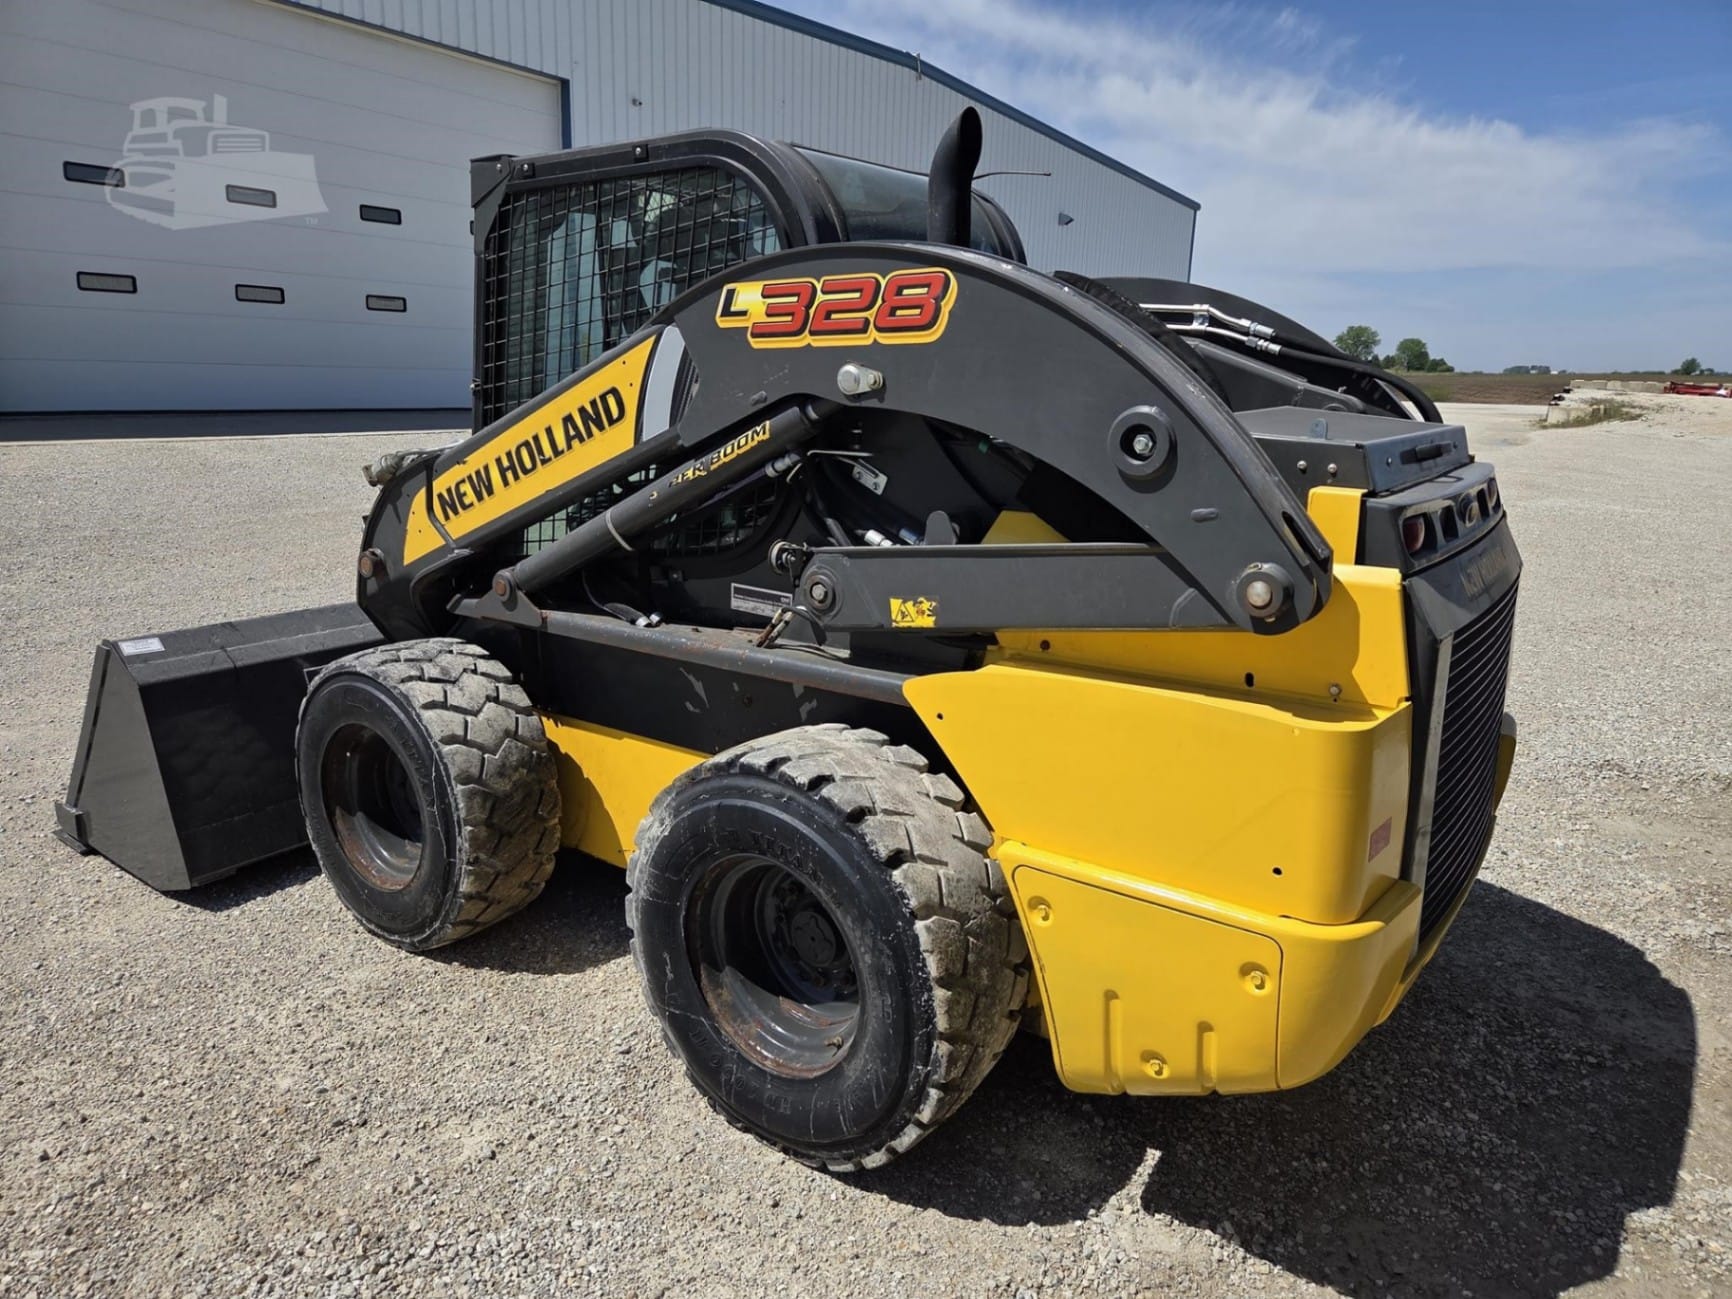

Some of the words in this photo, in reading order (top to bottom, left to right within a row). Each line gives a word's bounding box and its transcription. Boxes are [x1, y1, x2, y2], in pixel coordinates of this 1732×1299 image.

[718, 269, 955, 347] L328
[436, 465, 495, 521] NEW
[495, 386, 626, 488] HOLLAND
[709, 421, 771, 470] BOOM
